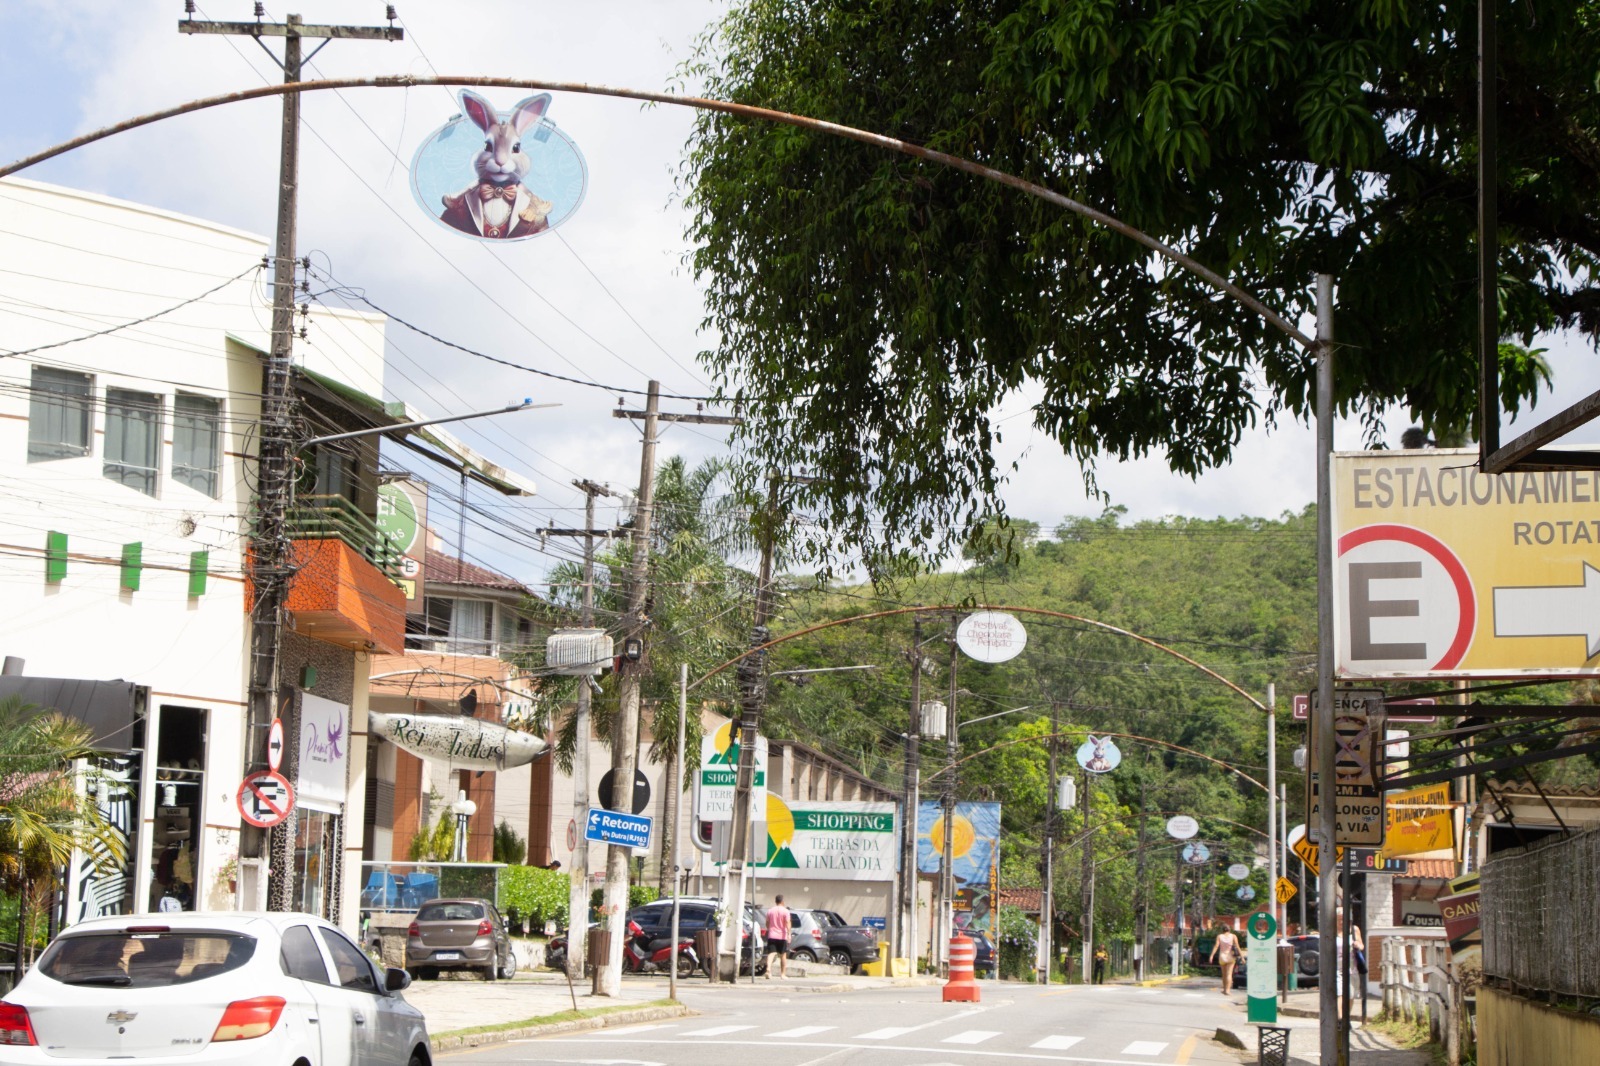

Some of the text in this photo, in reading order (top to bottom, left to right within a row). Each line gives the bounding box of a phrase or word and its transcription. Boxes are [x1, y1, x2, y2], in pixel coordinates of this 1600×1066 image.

[1349, 562, 1427, 660] E
[394, 718, 425, 747] Rei
[707, 773, 758, 784] SHOPG
[602, 815, 649, 833] Retorno
[807, 813, 886, 830] SHOPPING
[1348, 823, 1370, 832] VIA
[810, 837, 879, 851] TERRAS DA
[806, 851, 882, 870] FINLÂNDIA
[1406, 915, 1444, 926] POUSA
